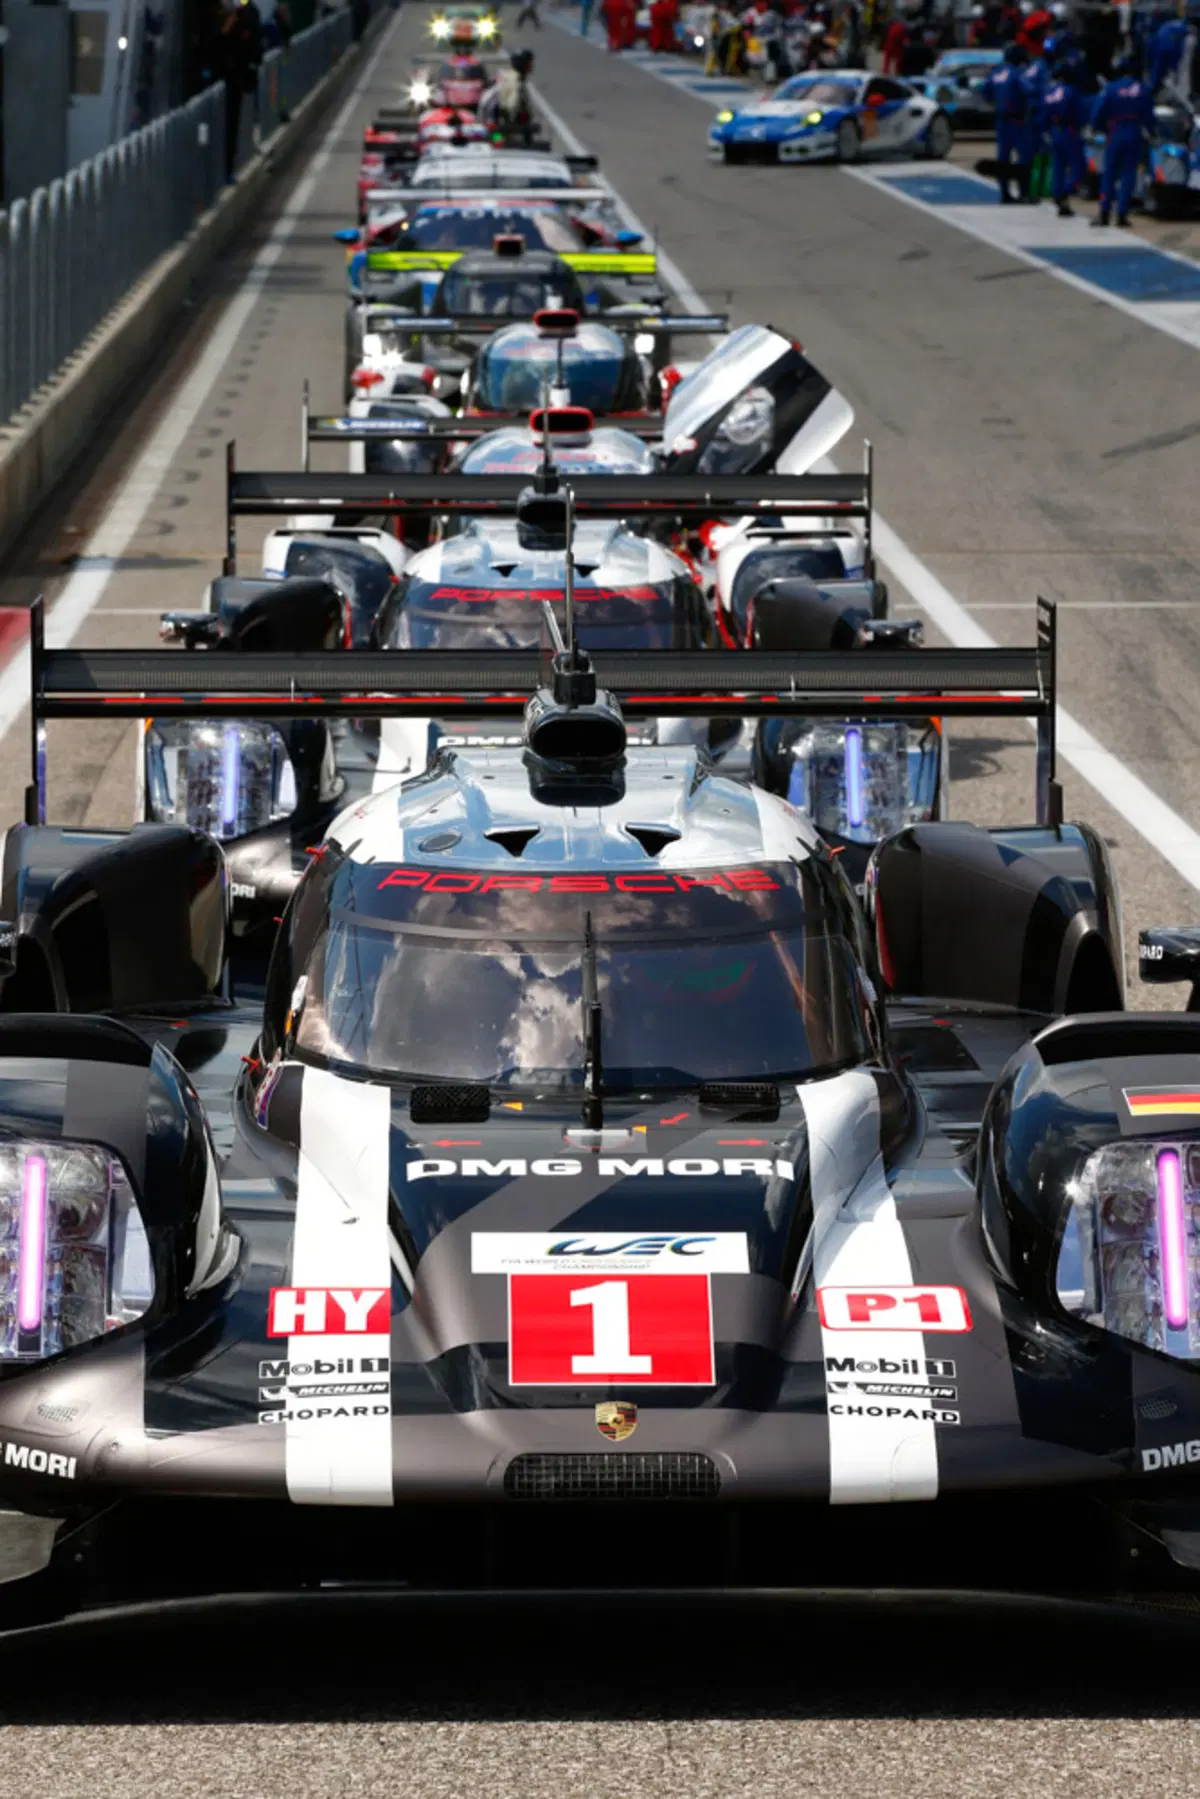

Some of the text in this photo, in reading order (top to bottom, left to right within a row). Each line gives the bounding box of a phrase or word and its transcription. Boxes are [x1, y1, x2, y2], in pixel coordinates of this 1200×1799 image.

[430, 587, 660, 602] PORSCHE
[230, 882, 256, 899] ORI
[377, 868, 781, 894] PORSCHE
[406, 1158, 794, 1182] DMG MORI
[547, 1236, 717, 1256] WEC
[273, 1289, 386, 1333] HY
[846, 1293, 943, 1323] P1
[570, 1280, 653, 1375] 1
[260, 1358, 354, 1378] Mobil
[825, 1357, 920, 1375] Mobil
[299, 1383, 387, 1397] MICHELIN
[865, 1383, 954, 1398] MICHELIN
[260, 1405, 390, 1423] CHOPARD
[829, 1404, 959, 1423] CHOPARD
[4, 1441, 77, 1480] MORI
[1141, 1438, 1200, 1472] DMG
